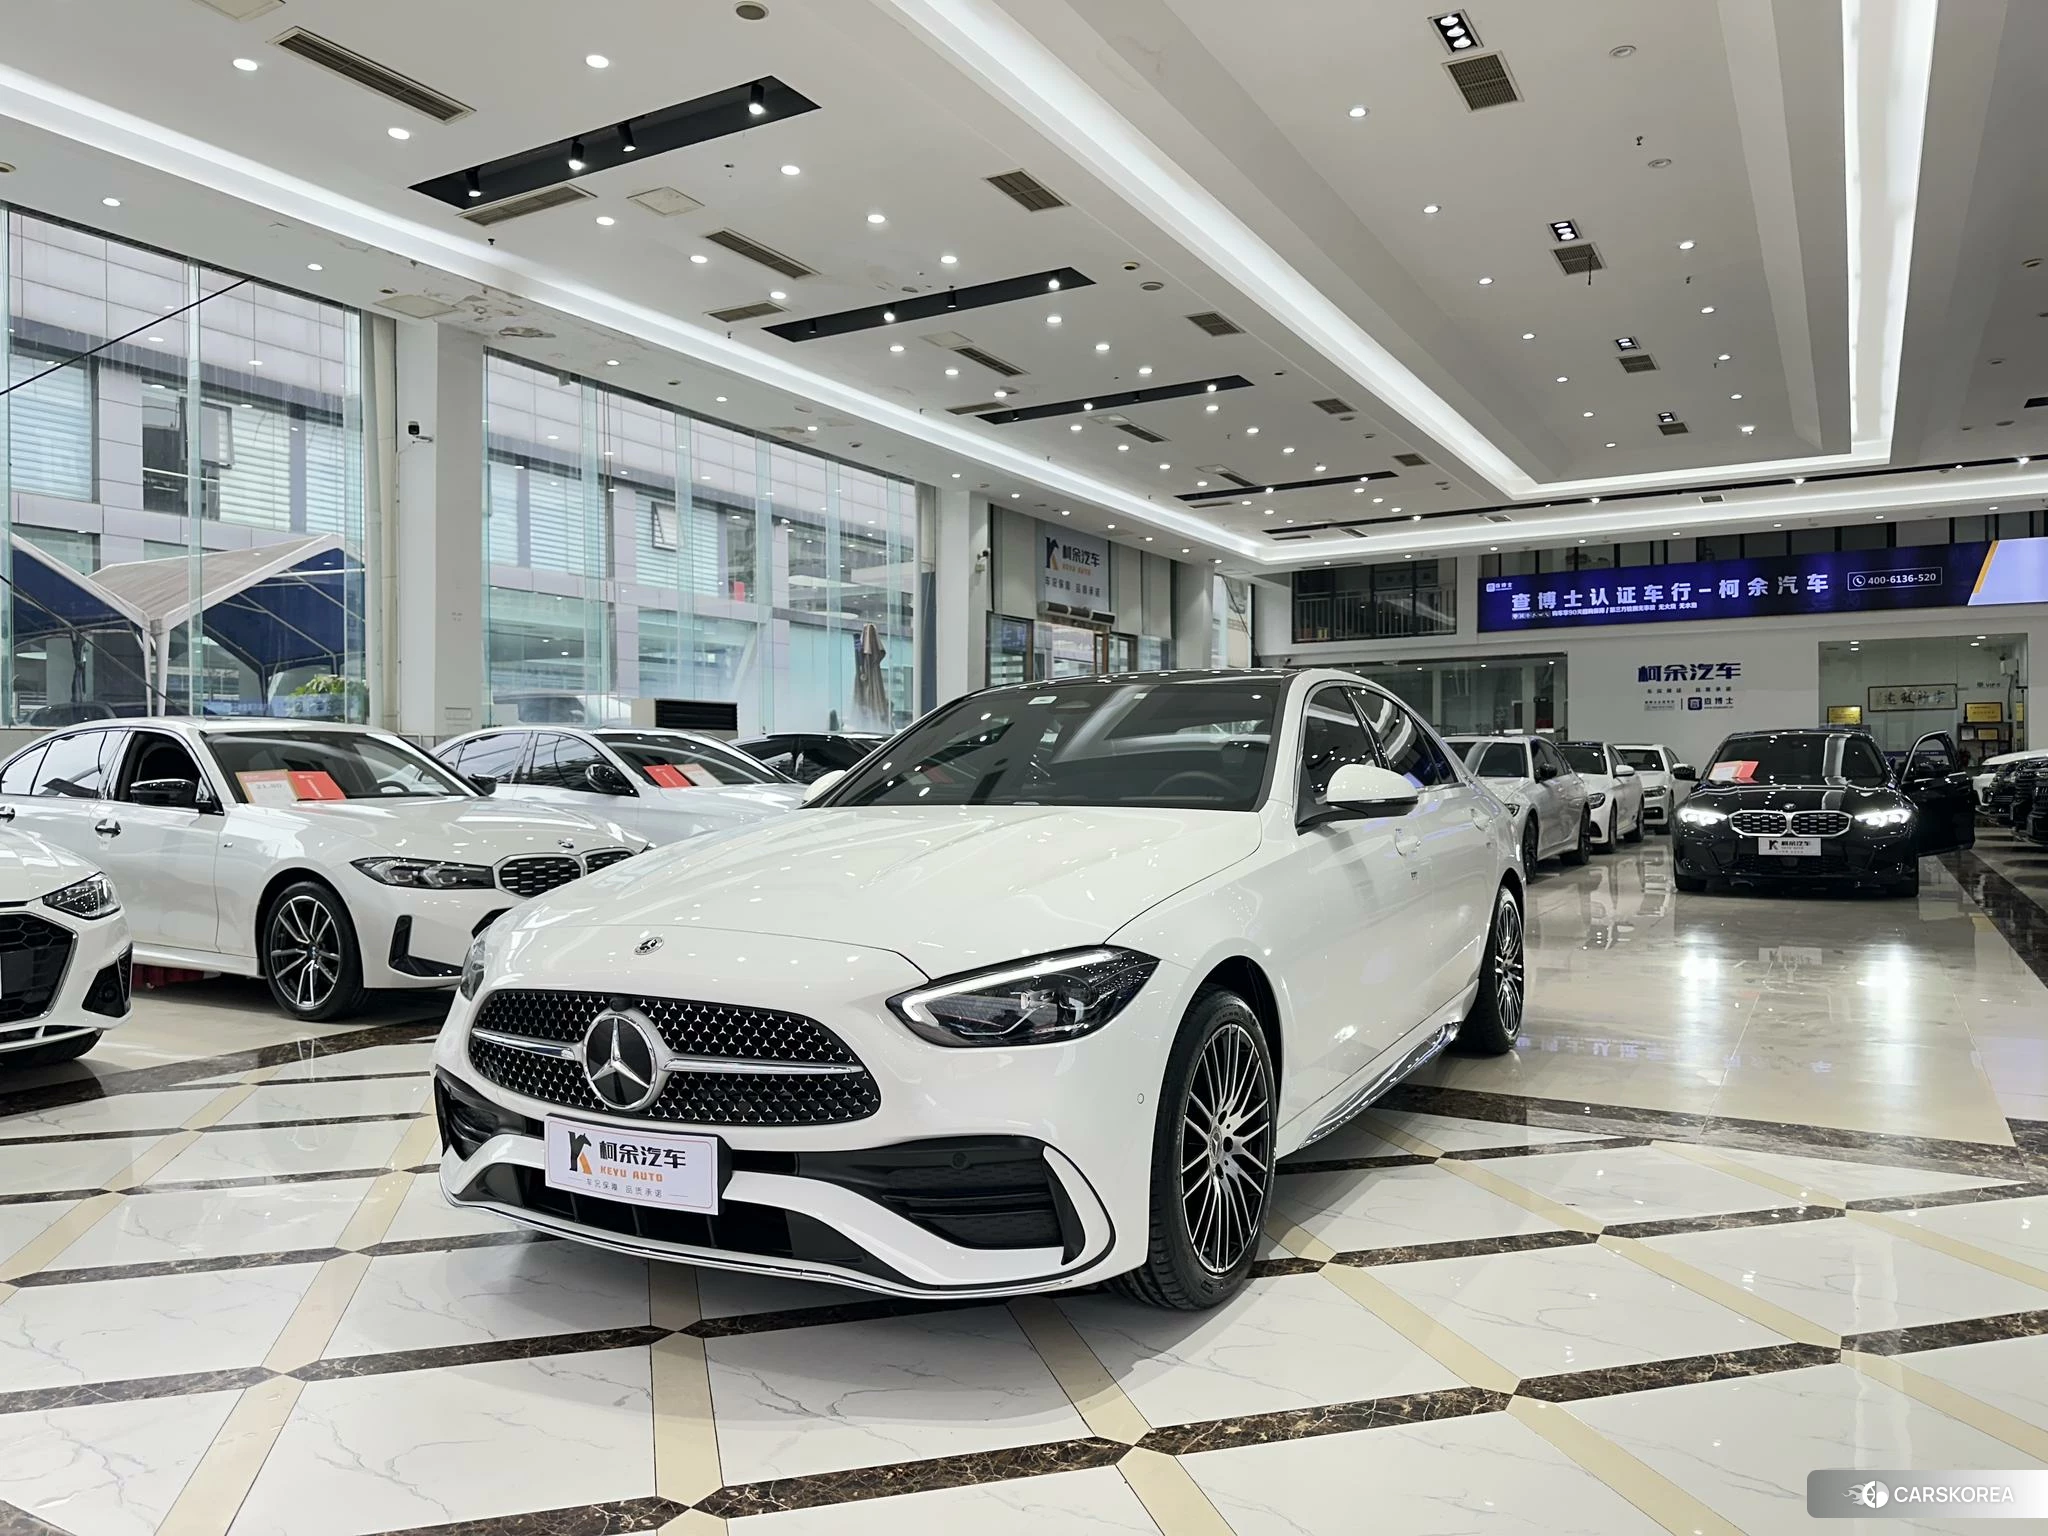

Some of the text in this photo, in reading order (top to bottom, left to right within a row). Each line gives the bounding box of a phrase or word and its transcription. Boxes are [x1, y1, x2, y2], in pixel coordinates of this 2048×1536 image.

[1868, 573, 1937, 586] 400-6136-520
[1638, 663, 1741, 682] 柯余汽车
[599, 1141, 686, 1169] 柯余汽车
[600, 1166, 663, 1182] KEYU AUTO
